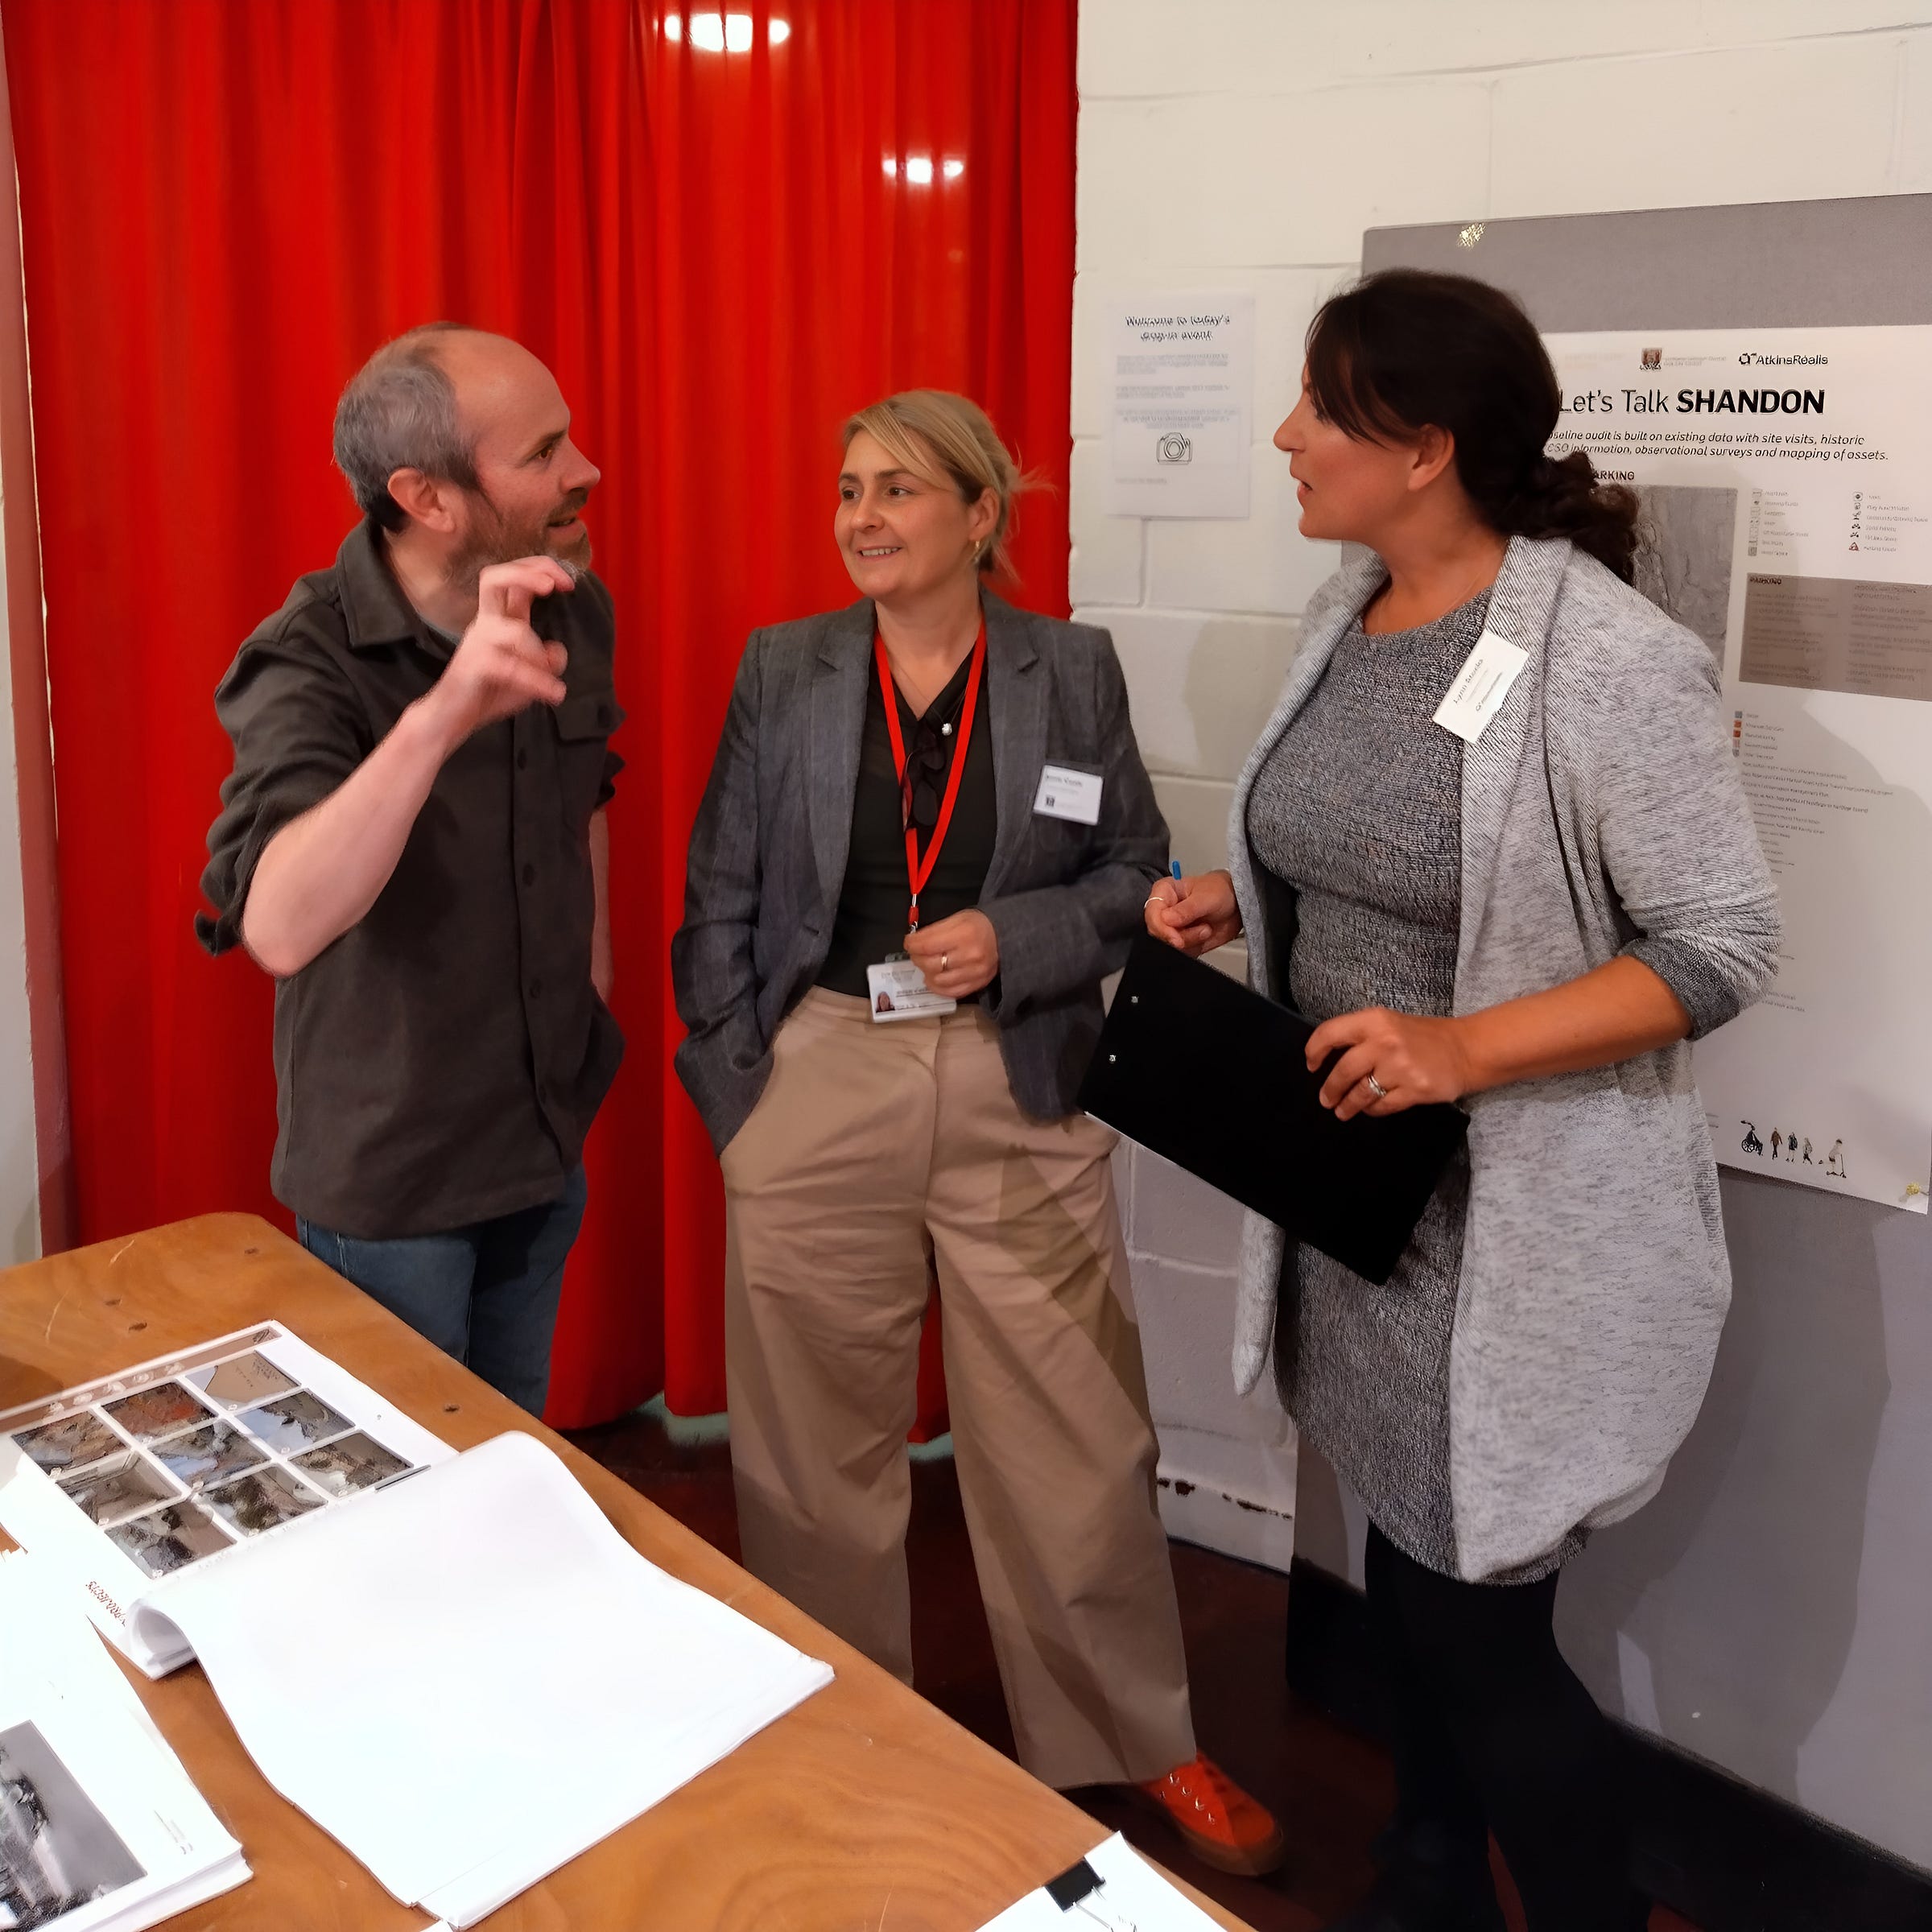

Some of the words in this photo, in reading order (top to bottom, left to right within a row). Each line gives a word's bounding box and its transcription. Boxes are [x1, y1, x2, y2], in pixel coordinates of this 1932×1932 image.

[1559, 390, 1612, 413] Let's
[1621, 390, 1669, 413] Talk
[1676, 390, 1824, 414] SHANDON
[1585, 431, 1612, 440] audit
[1613, 431, 1621, 440] is
[1624, 431, 1647, 440] built
[1665, 431, 1705, 443] existing
[1708, 432, 1732, 442] data
[1736, 433, 1759, 443] with
[1762, 433, 1781, 444] site
[1785, 434, 1817, 444] visits,
[1821, 435, 1864, 445] historic
[1635, 447, 1707, 456] observational
[1710, 448, 1752, 459] surveys
[1755, 448, 1777, 457] and
[1779, 449, 1830, 460] mapping
[1834, 449, 1845, 461] of
[1847, 451, 1889, 460] assets.
